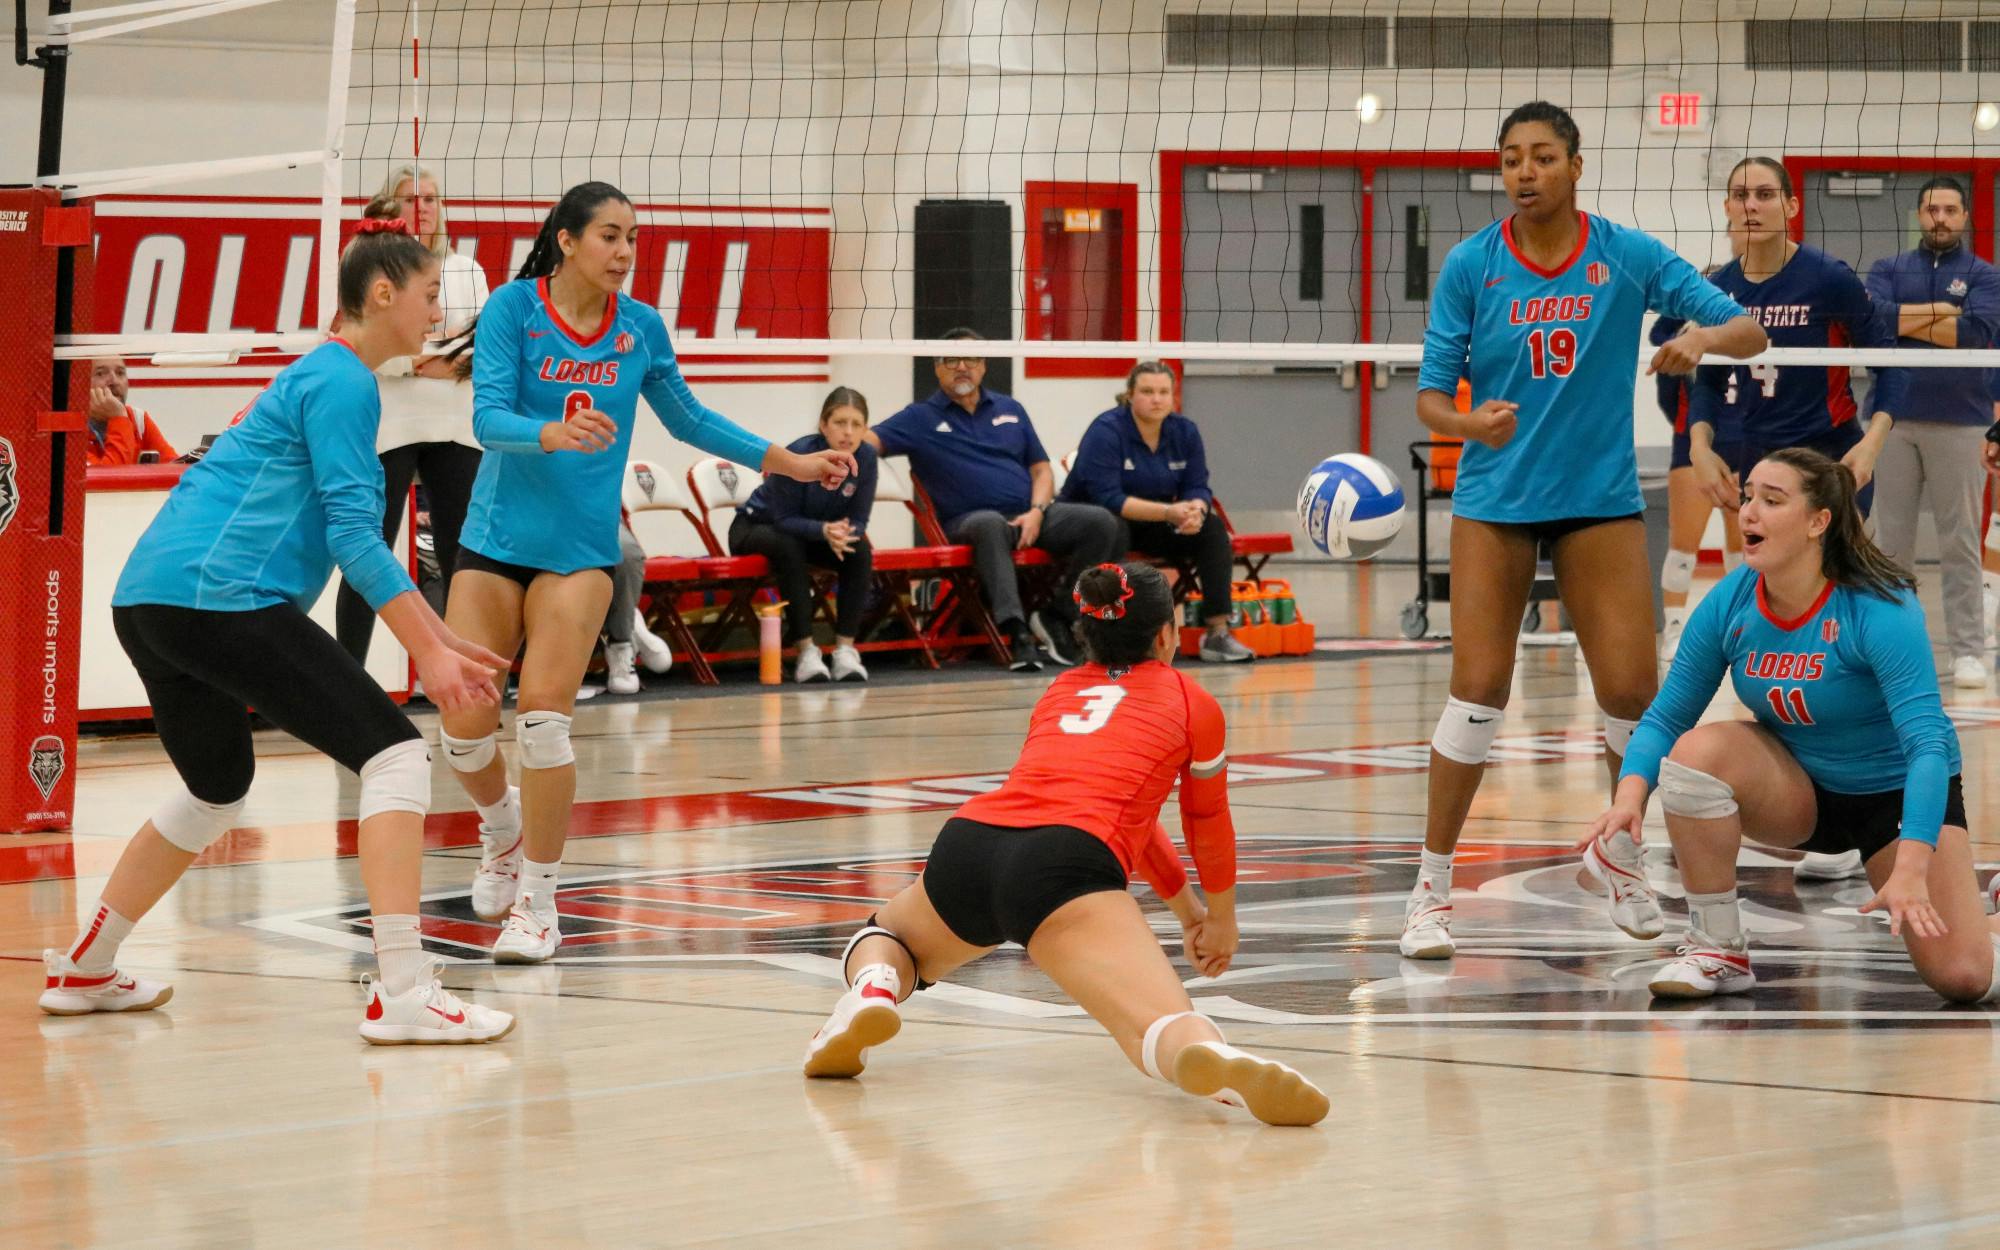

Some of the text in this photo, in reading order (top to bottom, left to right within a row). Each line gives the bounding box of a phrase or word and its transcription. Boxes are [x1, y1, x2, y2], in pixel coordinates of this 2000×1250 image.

[1659, 94, 1700, 126] EXIT
[18, 211, 28, 220] OF
[1509, 295, 1593, 325] LOBOS
[1763, 305, 1810, 327] STATE
[1528, 328, 1577, 379] 19
[539, 356, 619, 386] LOBOS
[45, 570, 60, 637] sports
[1745, 651, 1825, 680] LOBOS
[42, 641, 57, 724] imports
[1058, 685, 1128, 734] 3
[1766, 686, 1816, 725] 11
